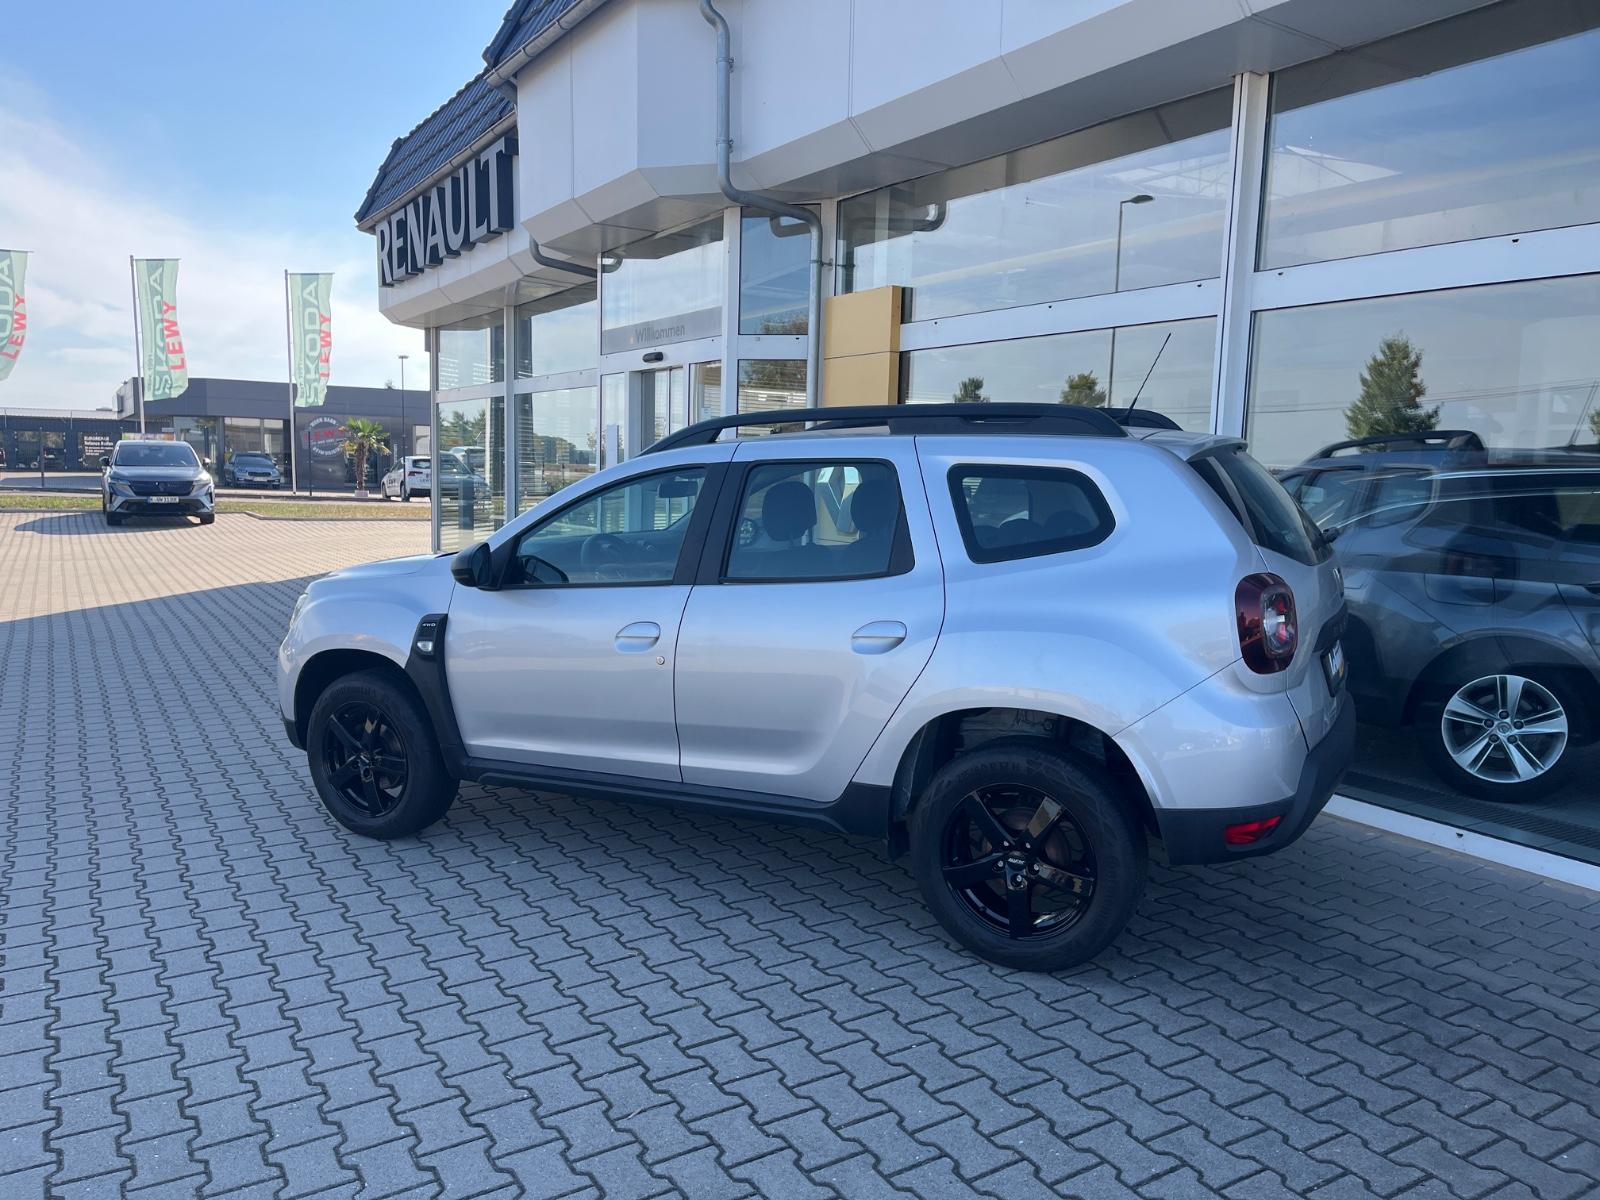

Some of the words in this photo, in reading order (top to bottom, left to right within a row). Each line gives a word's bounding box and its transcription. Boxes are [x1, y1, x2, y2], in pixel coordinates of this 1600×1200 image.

[375, 137, 505, 284] RENAULT
[161, 300, 187, 371] LEWY
[634, 324, 686, 344] Willkommen
